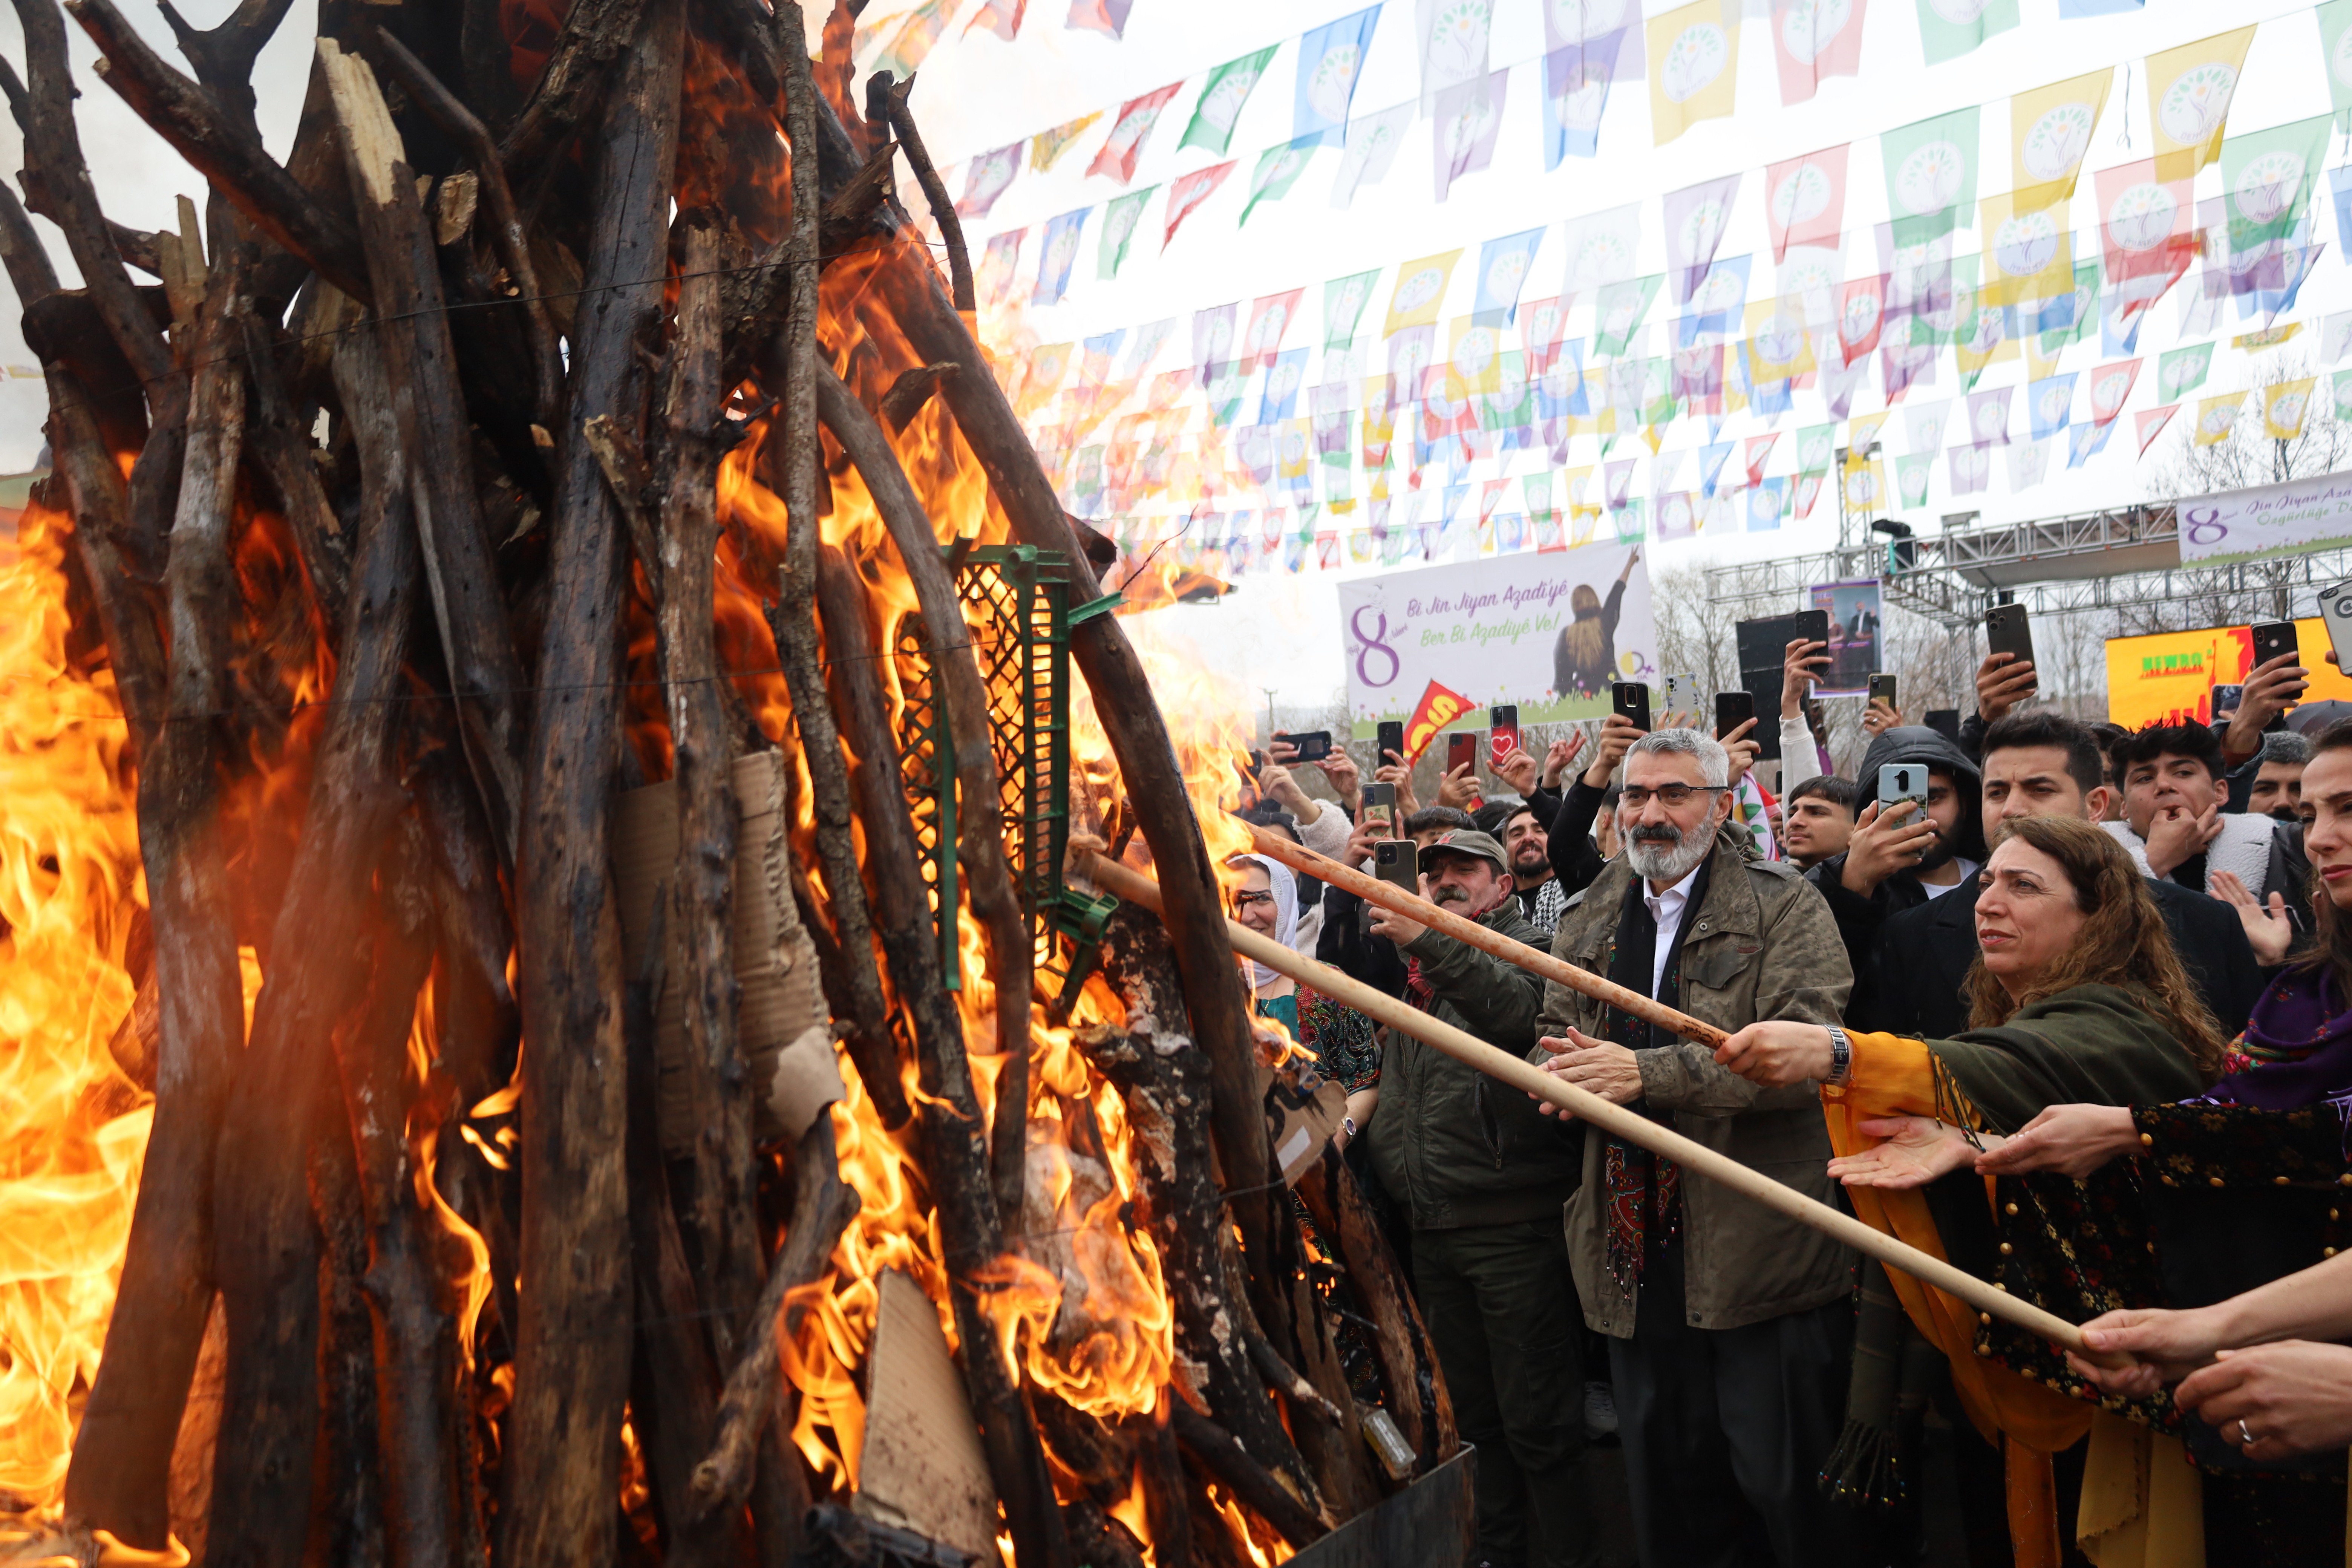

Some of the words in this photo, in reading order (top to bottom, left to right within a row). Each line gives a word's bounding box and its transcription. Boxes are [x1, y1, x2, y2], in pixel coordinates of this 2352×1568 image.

[2185, 507, 2228, 545] 8
[1407, 598, 1421, 617] Bi
[1426, 596, 1450, 615] Jin
[1454, 591, 1498, 619] Jiyan
[1351, 605, 1399, 688] 8
[1420, 628, 1446, 647] Ber
[1450, 624, 1465, 643] Bi
[1536, 611, 1560, 632] Ve!
